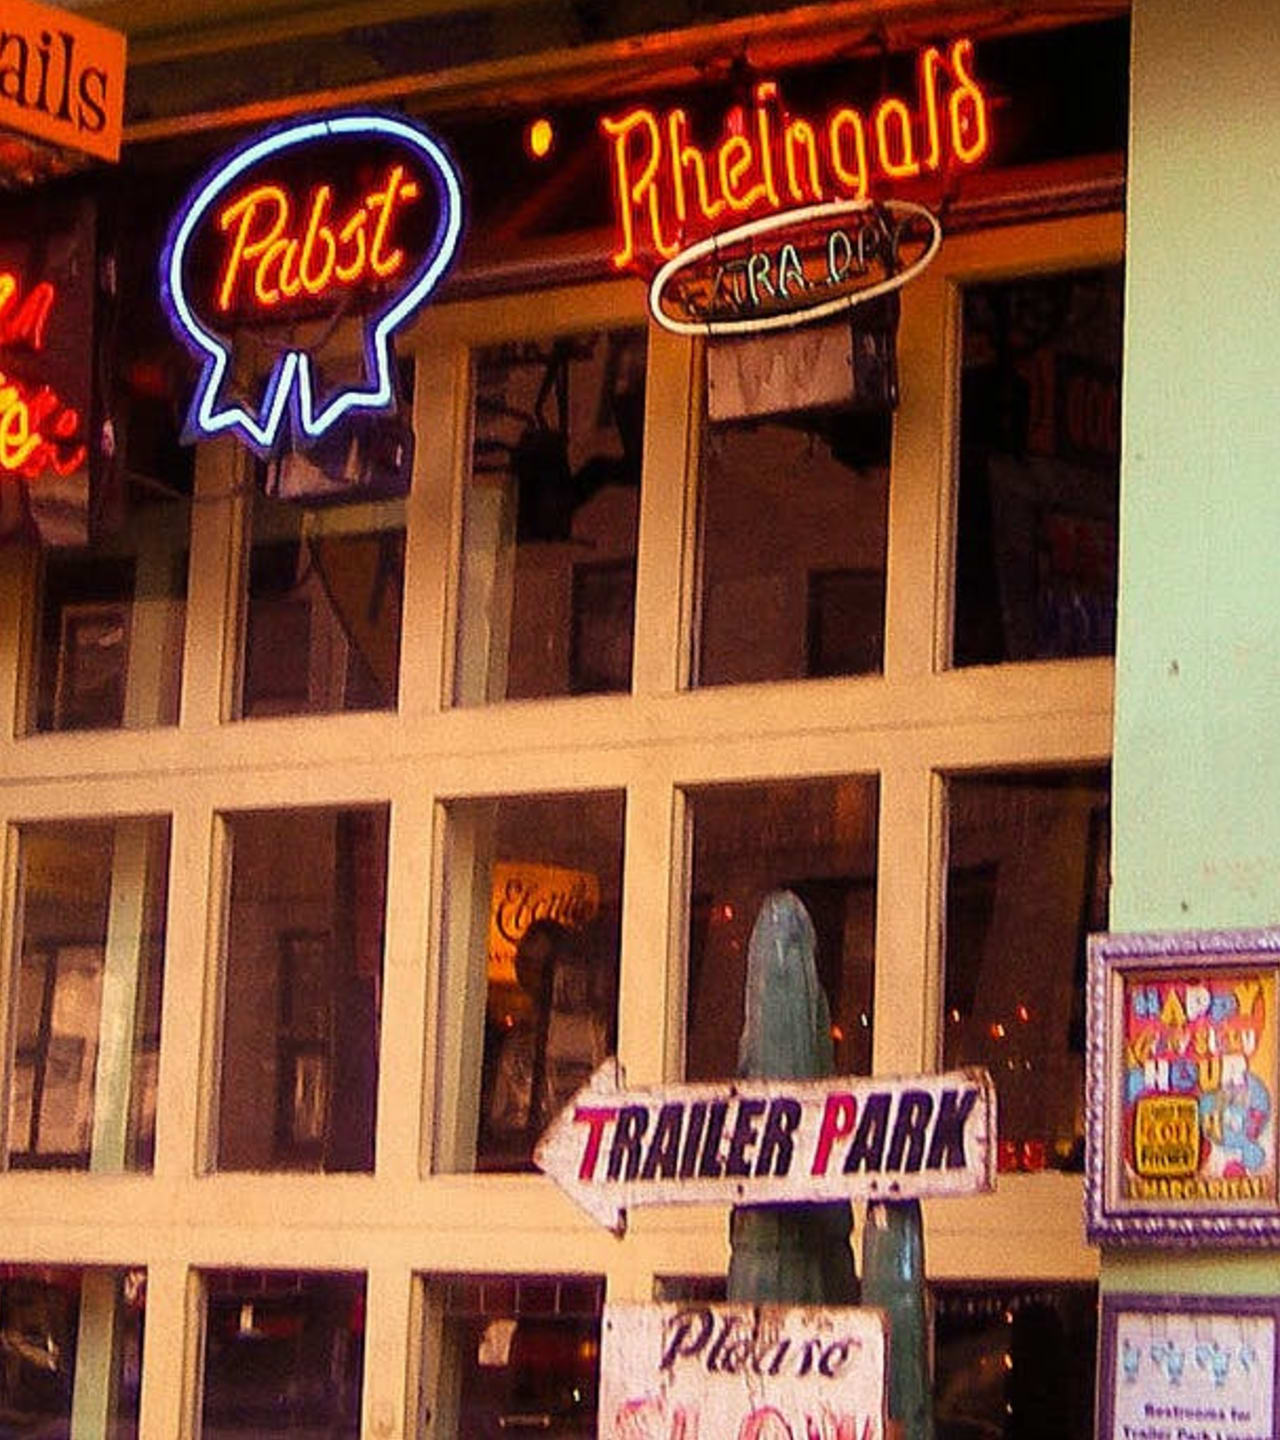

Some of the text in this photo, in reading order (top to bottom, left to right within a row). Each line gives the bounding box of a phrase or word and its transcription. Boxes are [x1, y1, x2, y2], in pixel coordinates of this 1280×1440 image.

[602, 37, 990, 269] Rheingold
[218, 165, 418, 311] Pabst
[573, 1088, 979, 1182] TRAILER PARK
